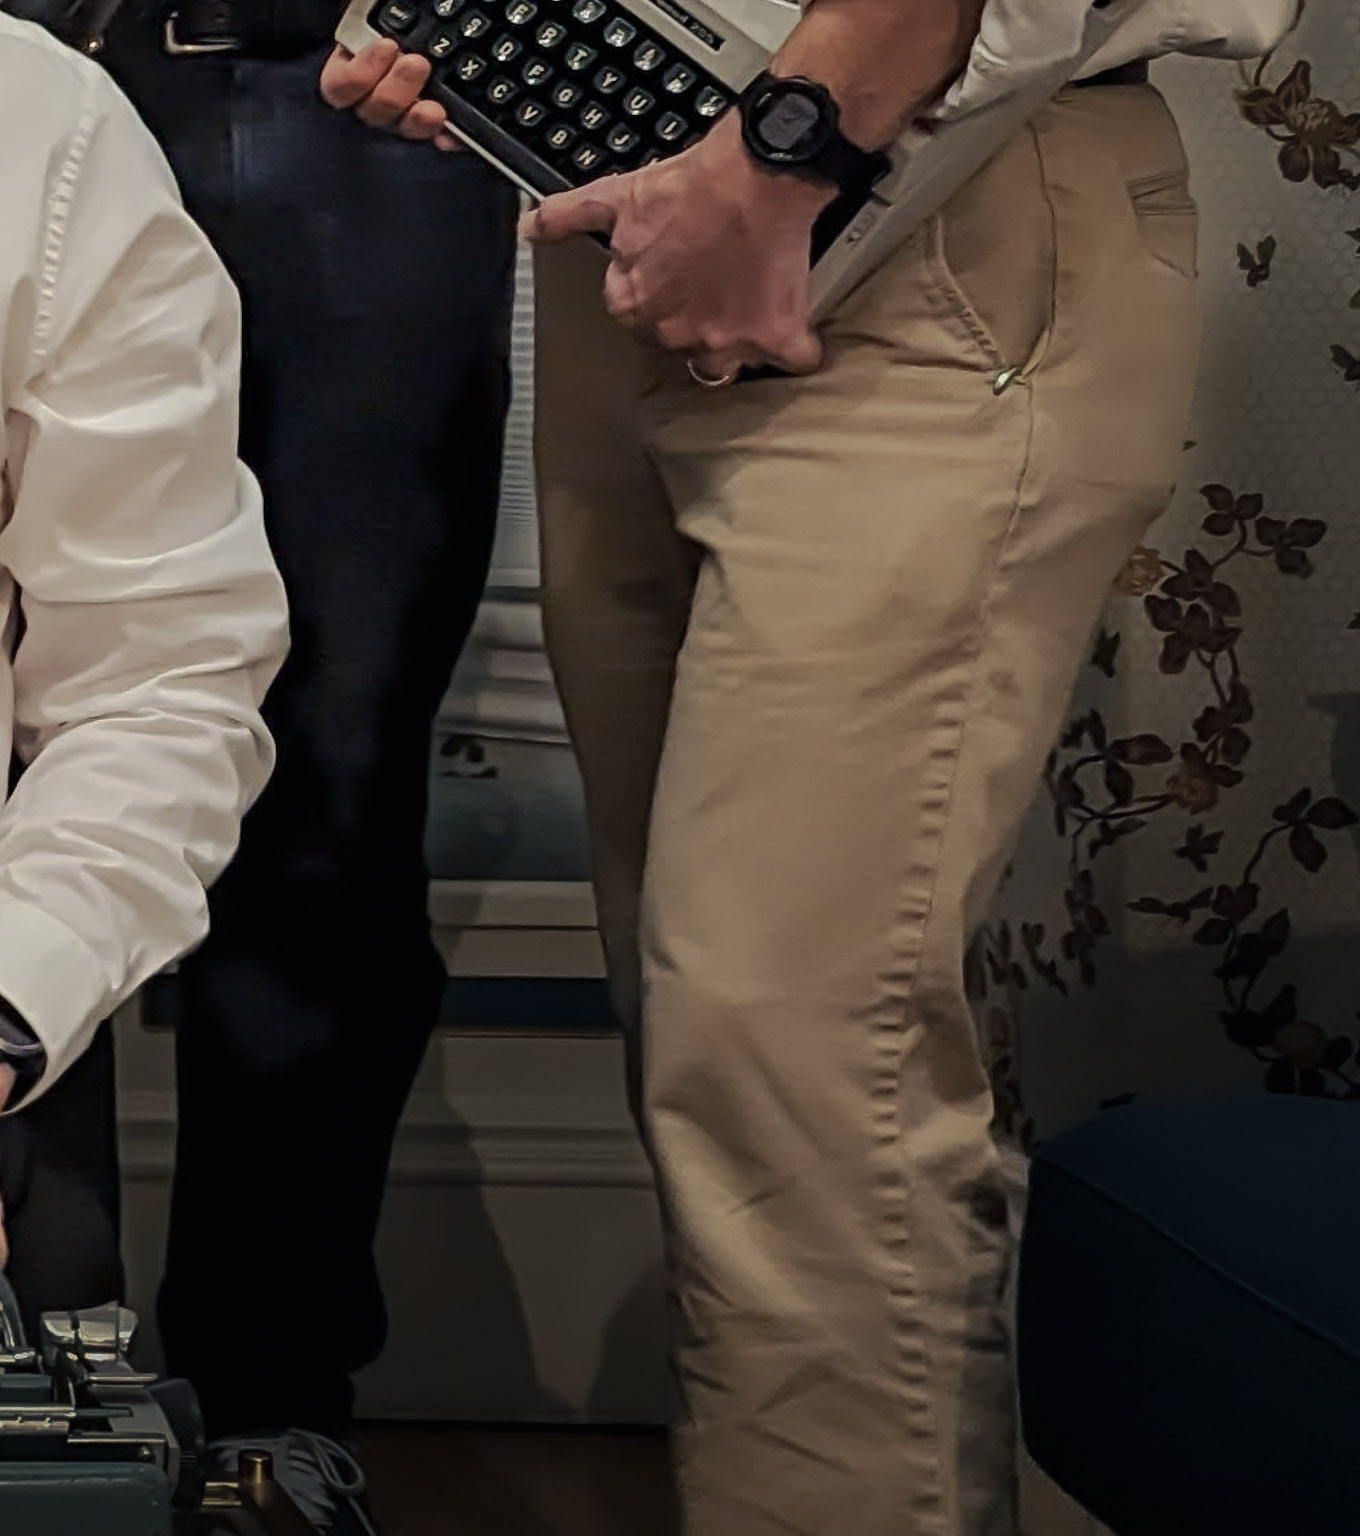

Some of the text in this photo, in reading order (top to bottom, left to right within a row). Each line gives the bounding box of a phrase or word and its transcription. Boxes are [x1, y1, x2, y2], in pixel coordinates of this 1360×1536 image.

[434, 38, 596, 165] Z X C V B N
[529, 64, 544, 76] F
[585, 109, 601, 124] H
[615, 134, 629, 145] J
[541, 27, 557, 41] R
[574, 49, 587, 62] T
[603, 73, 617, 87] Y
[631, 95, 646, 109] U
